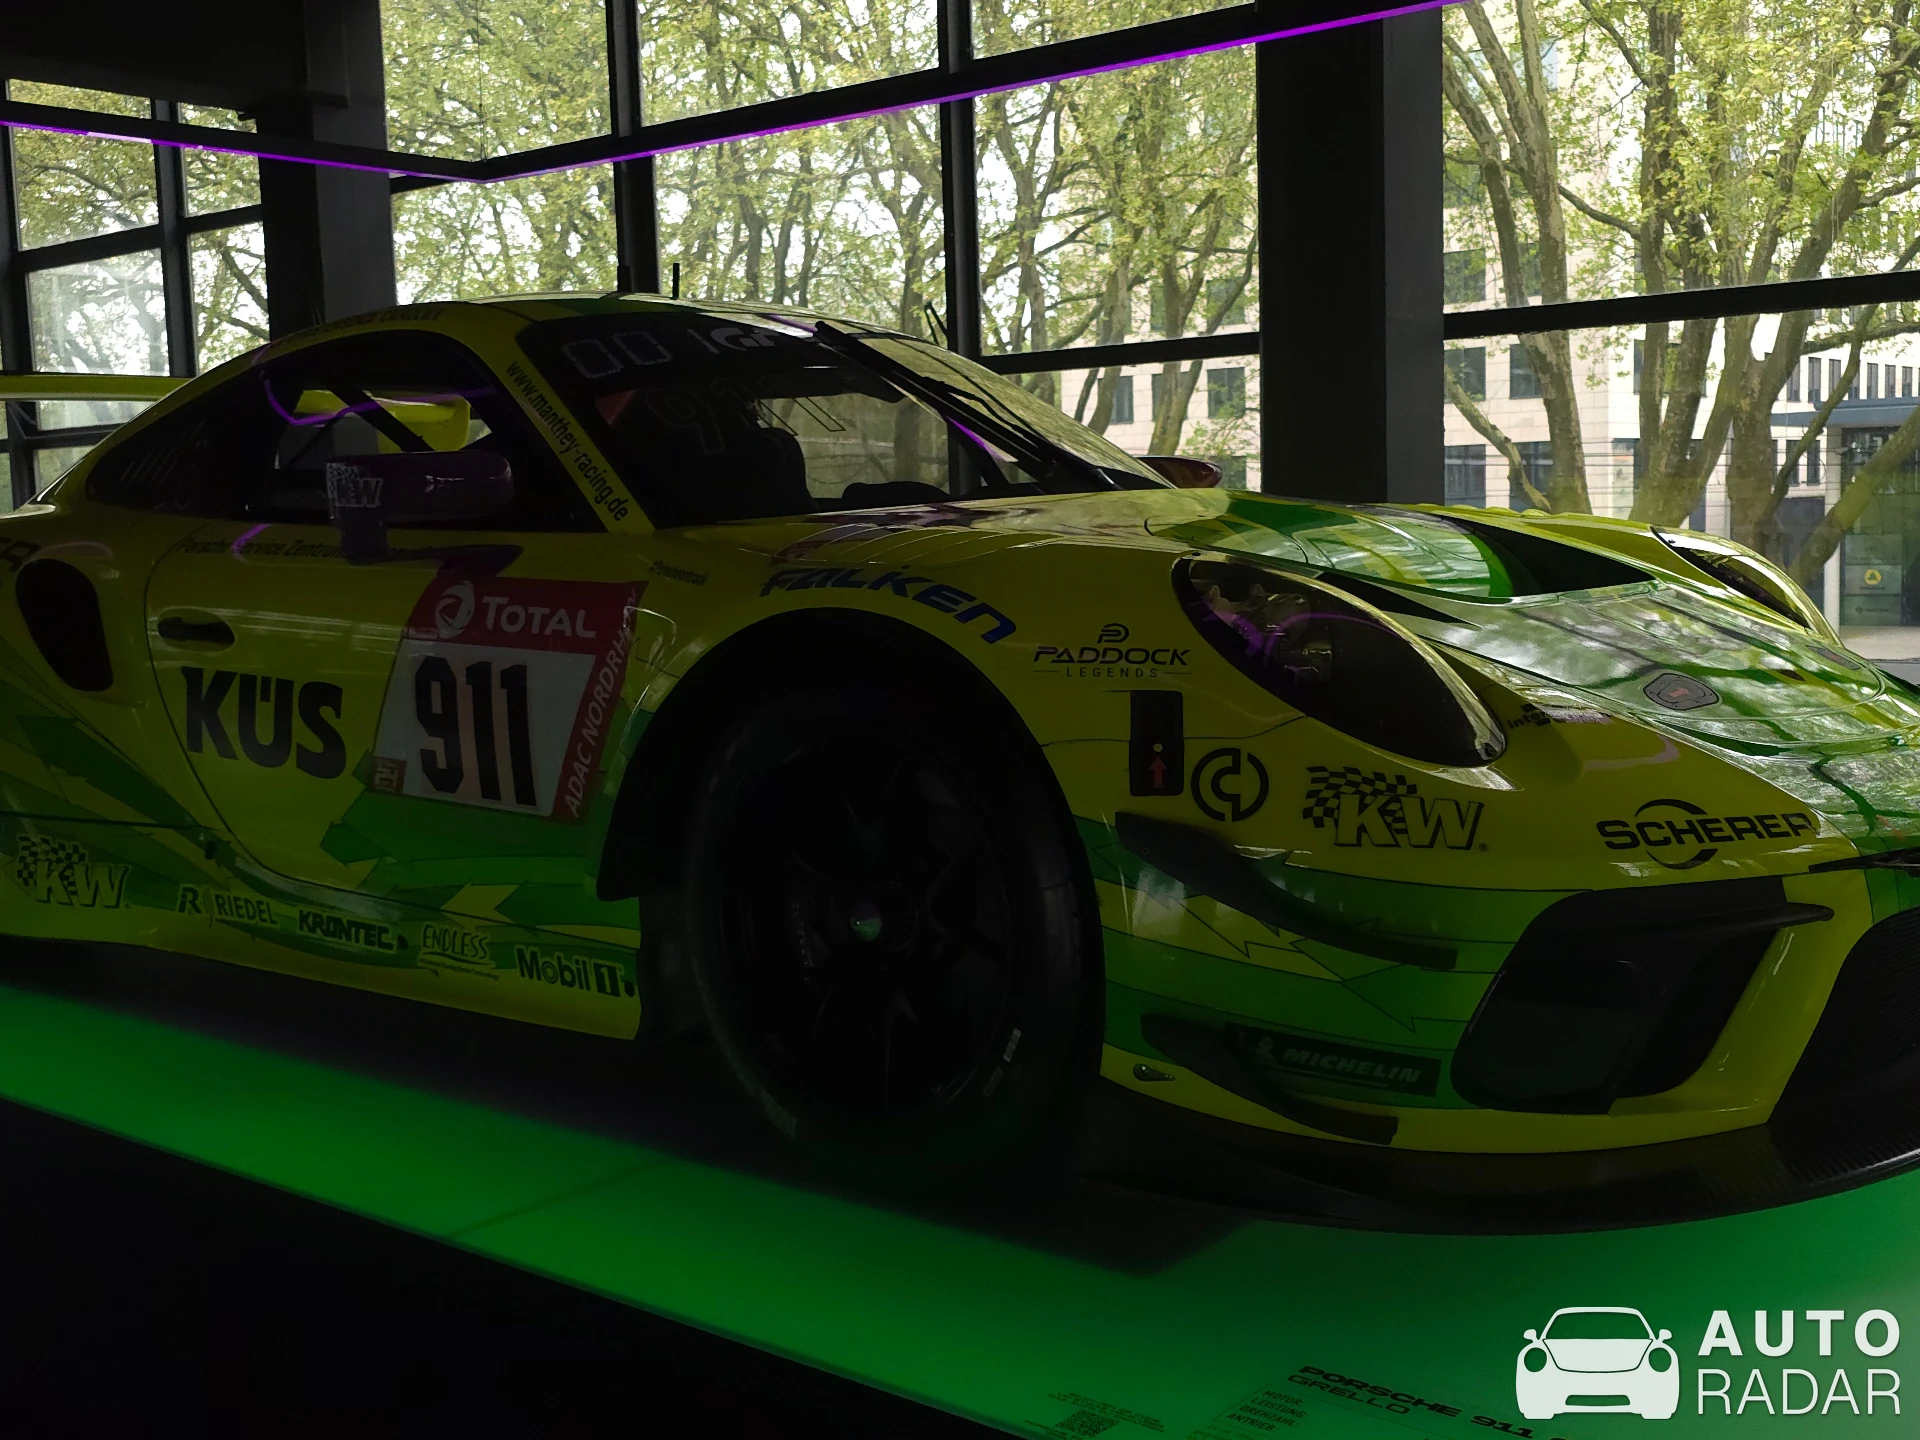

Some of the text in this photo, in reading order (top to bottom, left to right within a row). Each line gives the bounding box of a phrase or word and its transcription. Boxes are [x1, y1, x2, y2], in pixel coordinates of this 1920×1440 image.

[506, 361, 629, 522] www.manthey-racing.de
[759, 567, 1018, 645] FALKEN
[1033, 645, 1192, 667] PADDOCK
[1065, 667, 1160, 679] LEGENDS
[181, 665, 348, 780] KÜS
[414, 655, 538, 807] 911
[564, 742, 593, 819] ADAC
[1334, 791, 1485, 851] KW
[1595, 812, 1817, 850] SCHERER
[35, 859, 132, 910] KW
[214, 893, 279, 926] RIEDEL
[422, 924, 489, 960] ENDLESS
[514, 947, 592, 992] Mobil
[1281, 1047, 1422, 1084] MICHELIN
[1287, 1374, 1411, 1415] GRELLO
[1298, 1365, 1534, 1440] PORSCHE 911
